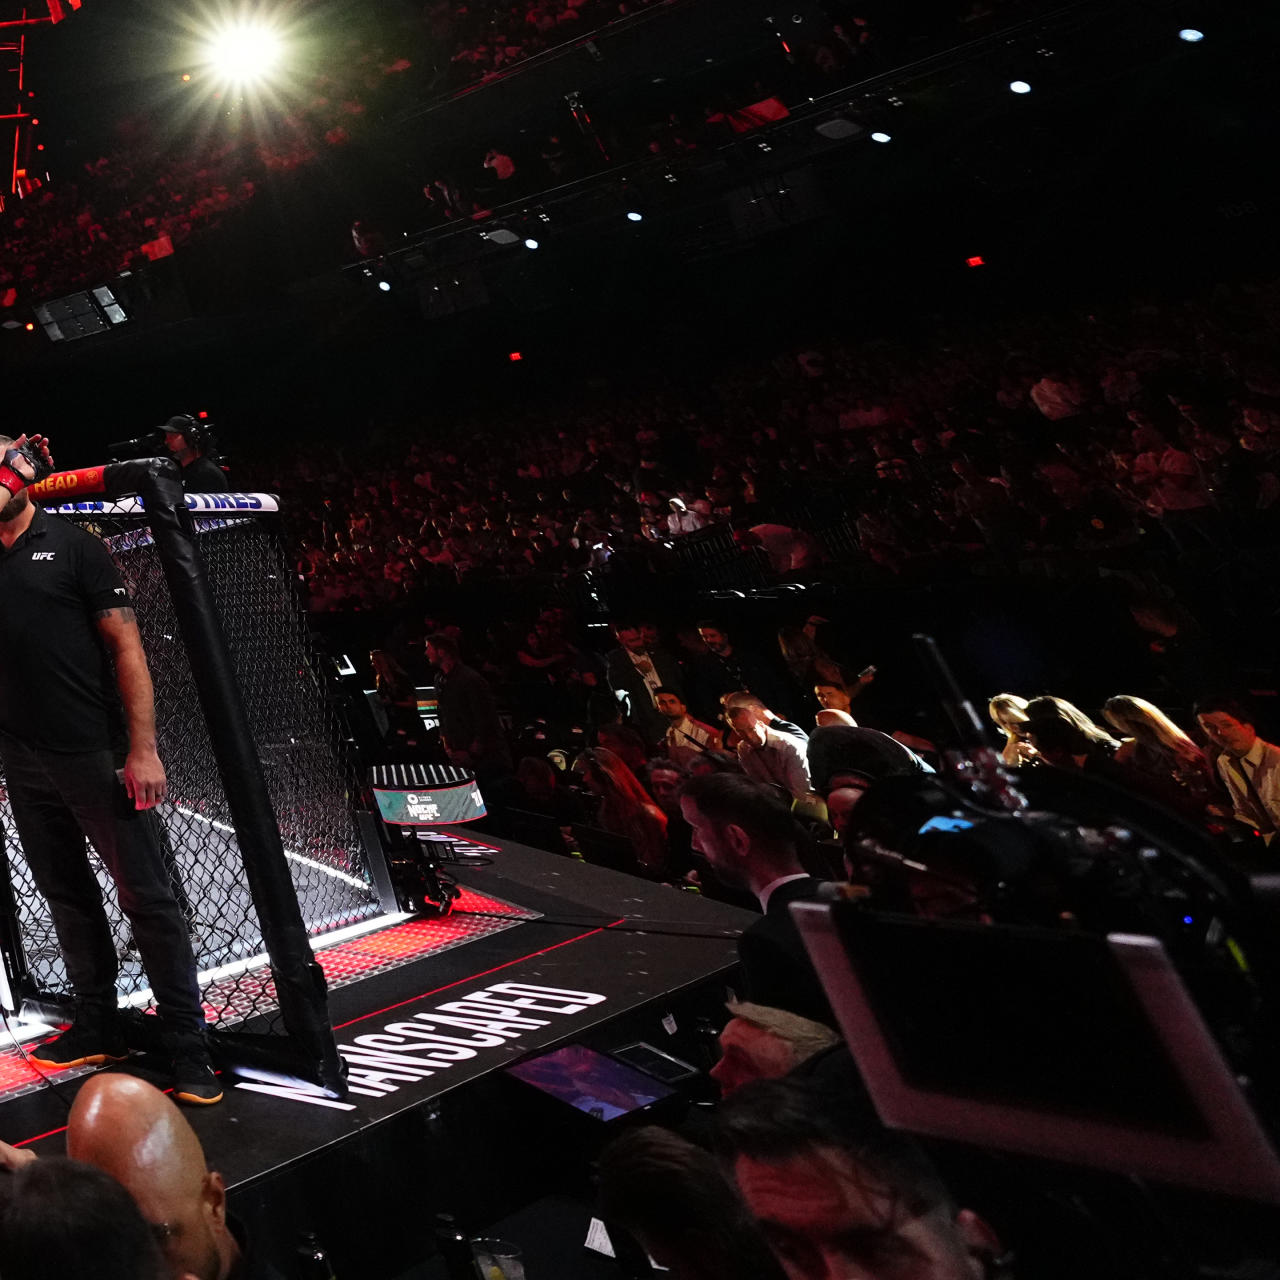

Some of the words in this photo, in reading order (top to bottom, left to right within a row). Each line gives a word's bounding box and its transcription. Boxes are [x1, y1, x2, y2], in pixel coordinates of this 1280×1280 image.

[34, 474, 78, 492] HEAD
[203, 493, 263, 510] TIRES
[31, 552, 56, 561] UFC
